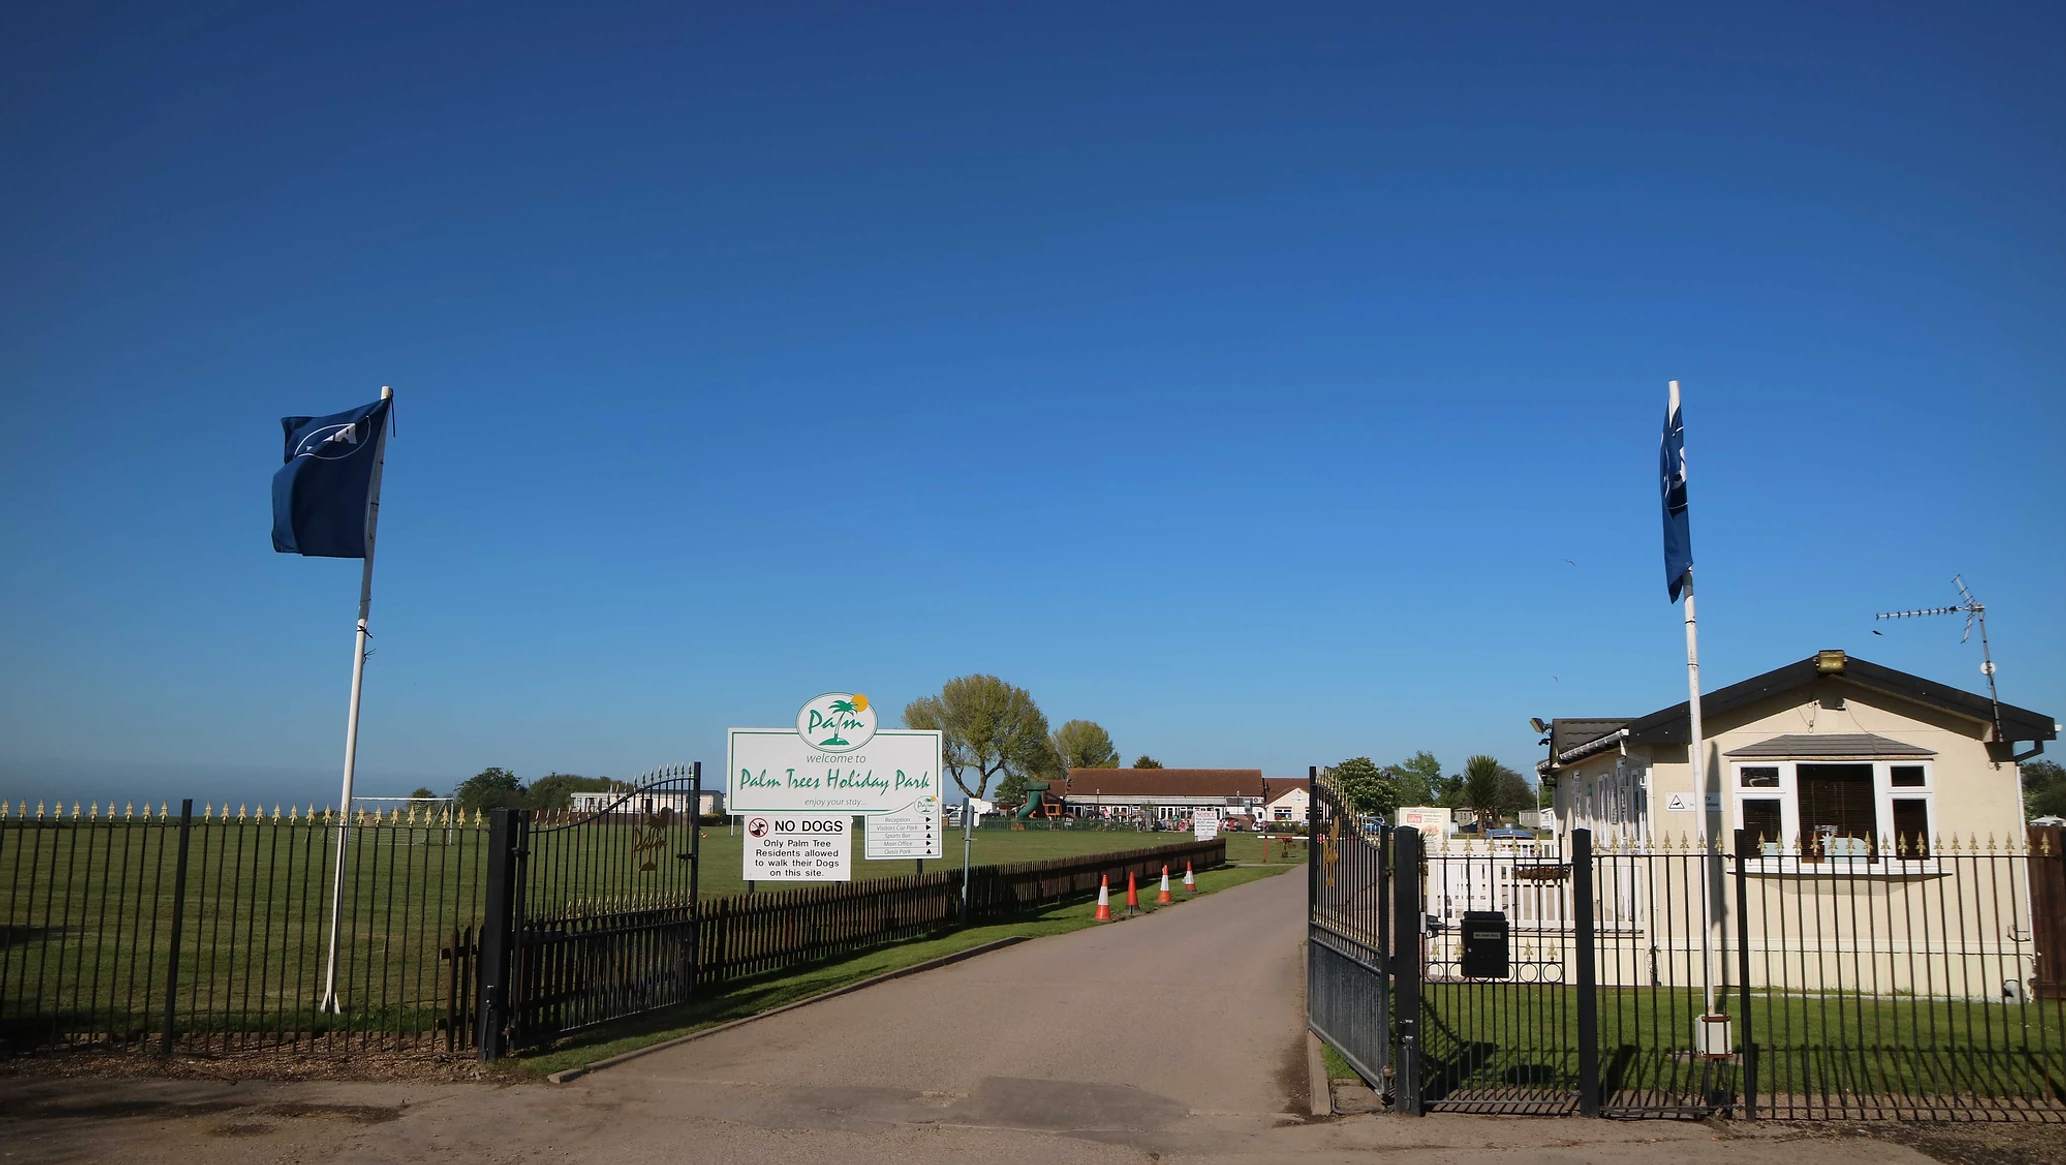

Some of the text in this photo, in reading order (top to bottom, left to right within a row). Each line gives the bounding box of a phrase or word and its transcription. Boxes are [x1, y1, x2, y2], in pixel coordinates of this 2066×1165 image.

[808, 708, 865, 735] Palm
[806, 753, 867, 764] welcome to
[739, 768, 930, 796] Palm Trees Holiday Park
[804, 798, 826, 807] enjoy
[826, 799, 845, 807] your
[774, 820, 843, 832] NO DOGS
[763, 839, 831, 848] Only Palm Tree
[755, 848, 839, 857] Residents allowed
[755, 859, 840, 868] to walk their Dogs
[769, 868, 824, 877] on this site.
